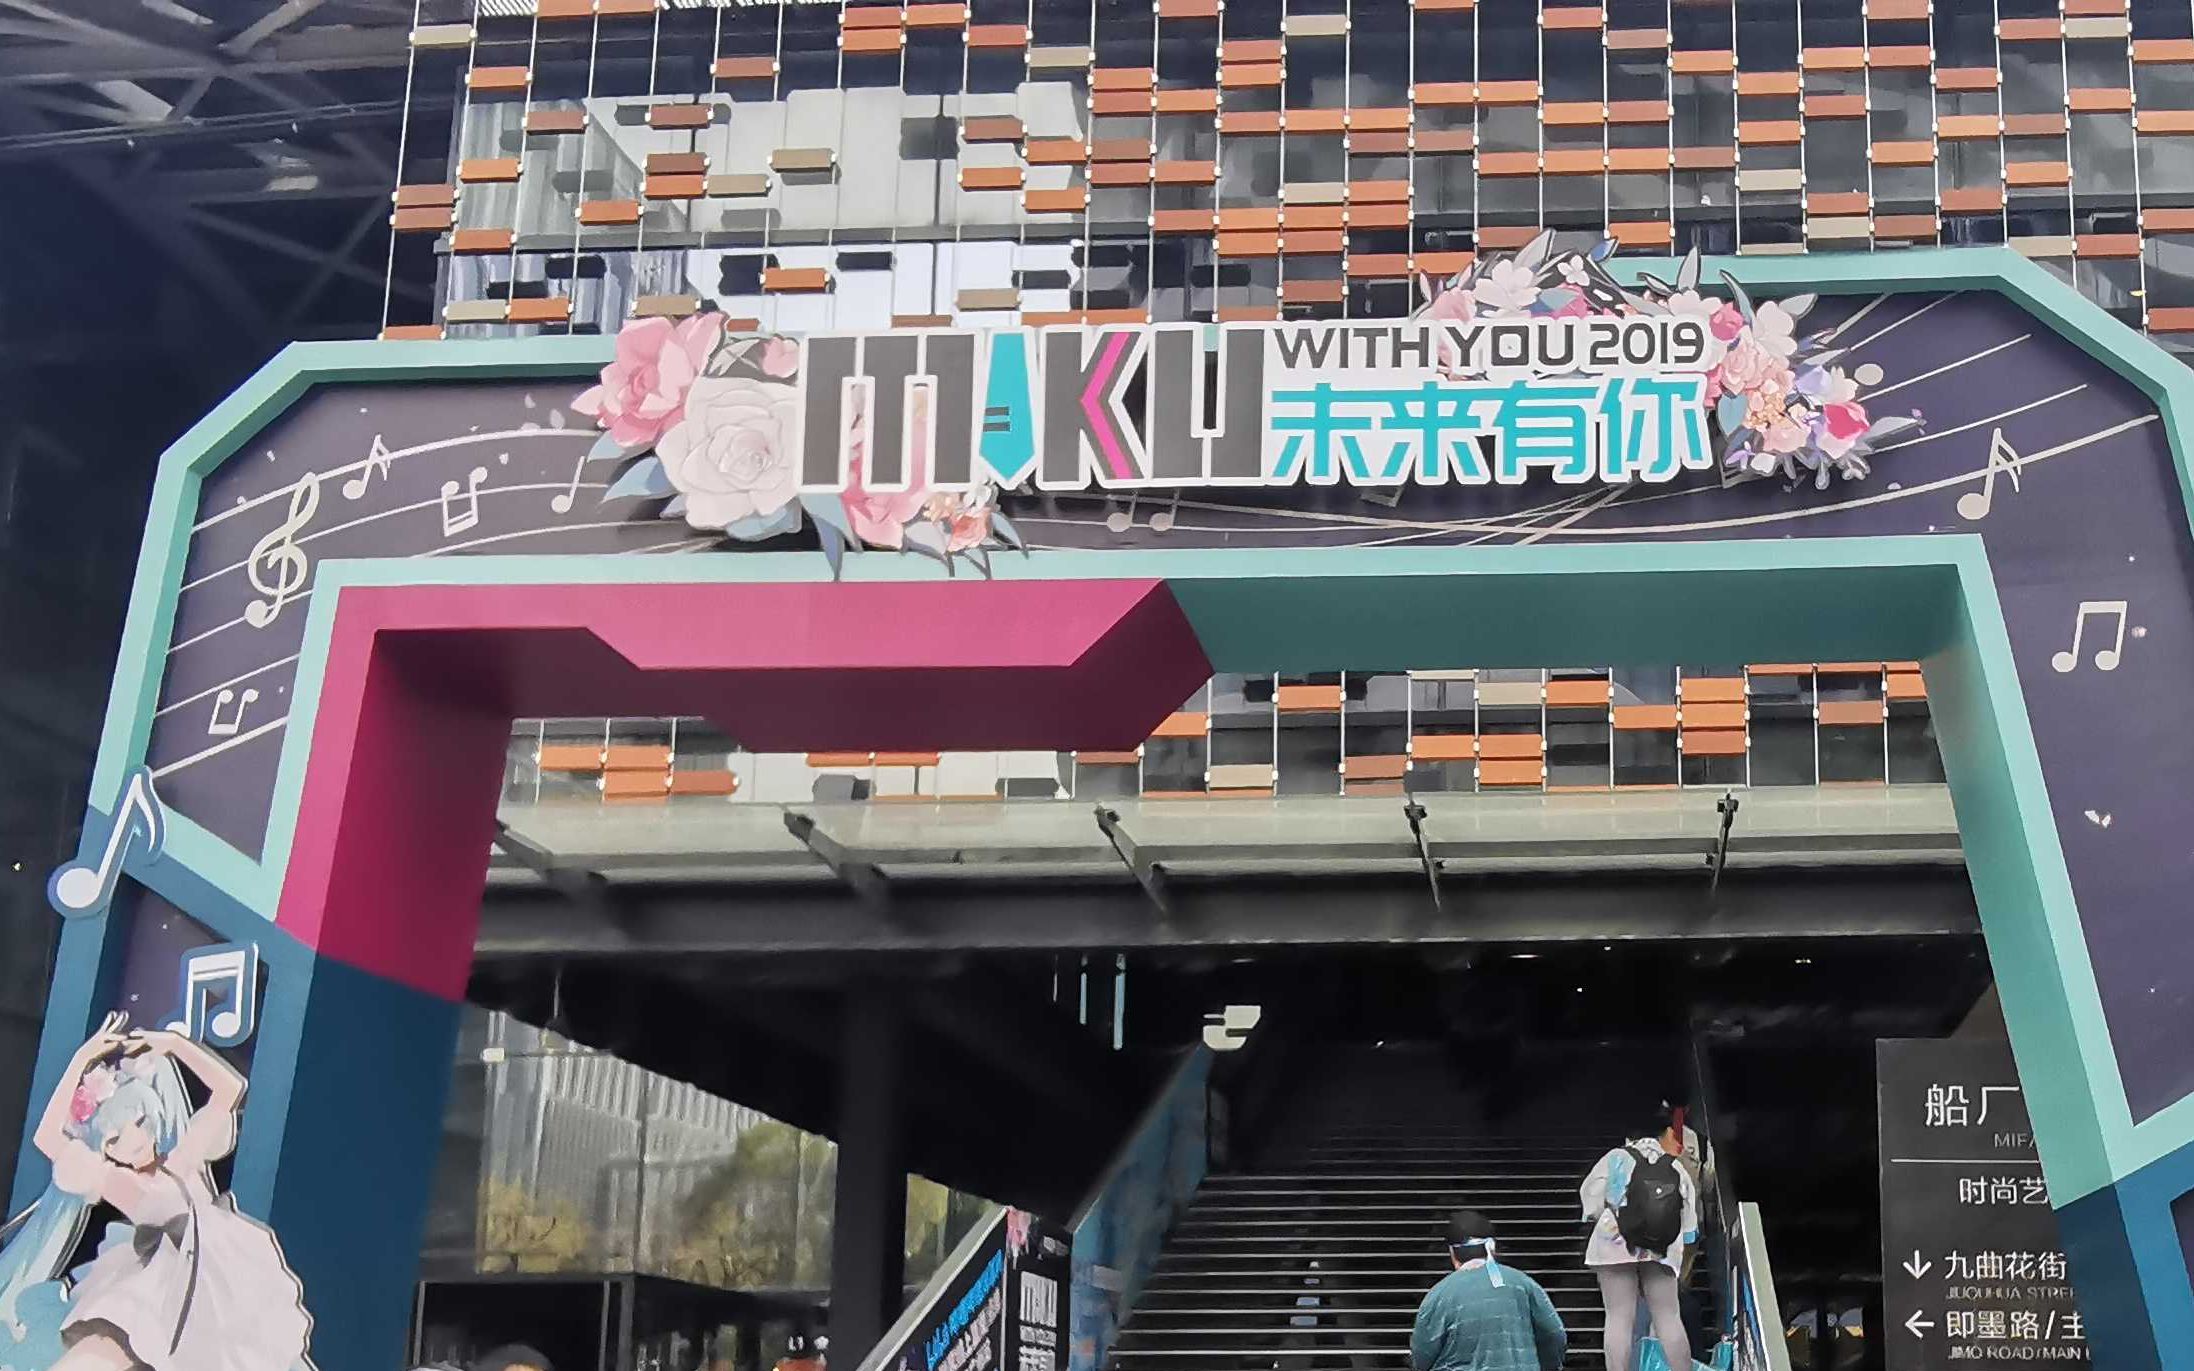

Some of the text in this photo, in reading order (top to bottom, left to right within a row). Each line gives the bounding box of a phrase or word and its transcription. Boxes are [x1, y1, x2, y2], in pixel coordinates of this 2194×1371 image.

[1275, 321, 1706, 369] WITH YOU 2019
[802, 328, 1266, 485] MIKU
[1271, 378, 1704, 478] 未来有你
[1924, 1083, 2020, 1127] 船厂
[1958, 1176, 2049, 1205] 时尚艺
[1944, 1250, 2068, 1281] 九曲花街
